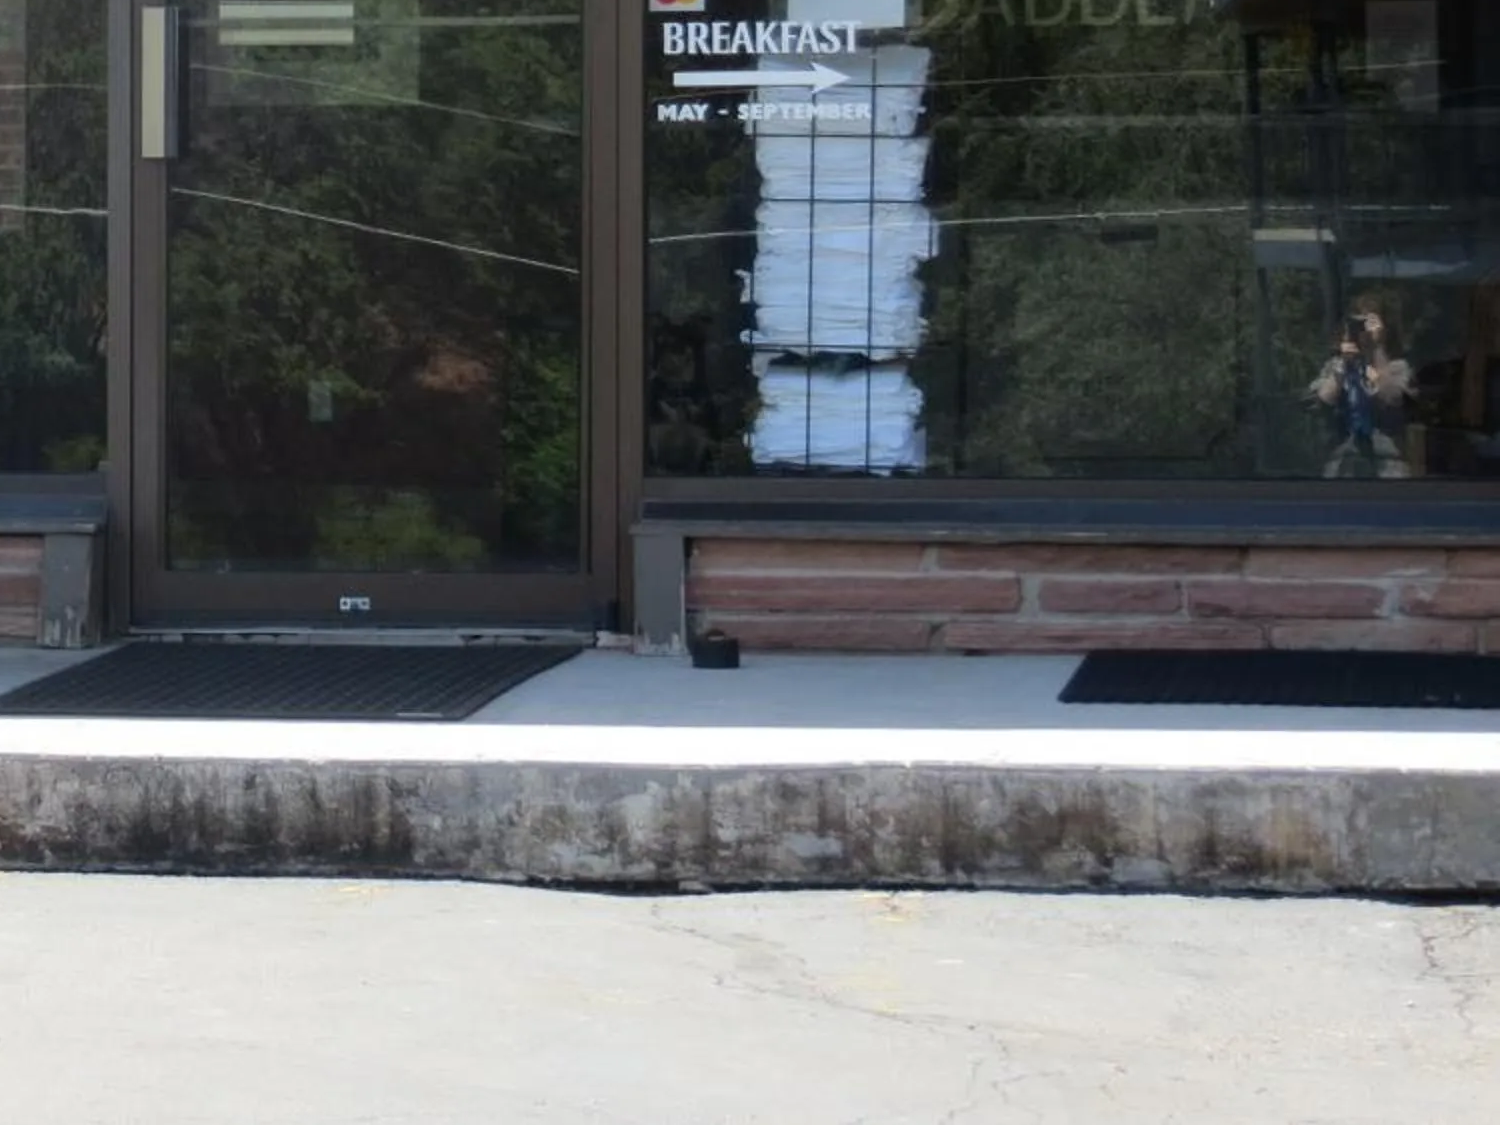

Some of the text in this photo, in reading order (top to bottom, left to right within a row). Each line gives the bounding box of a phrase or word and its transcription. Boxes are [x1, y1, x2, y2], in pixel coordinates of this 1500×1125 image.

[663, 20, 862, 55] BREAKFAST
[657, 103, 709, 122] MAY
[737, 102, 872, 122] SEPTEMBER
